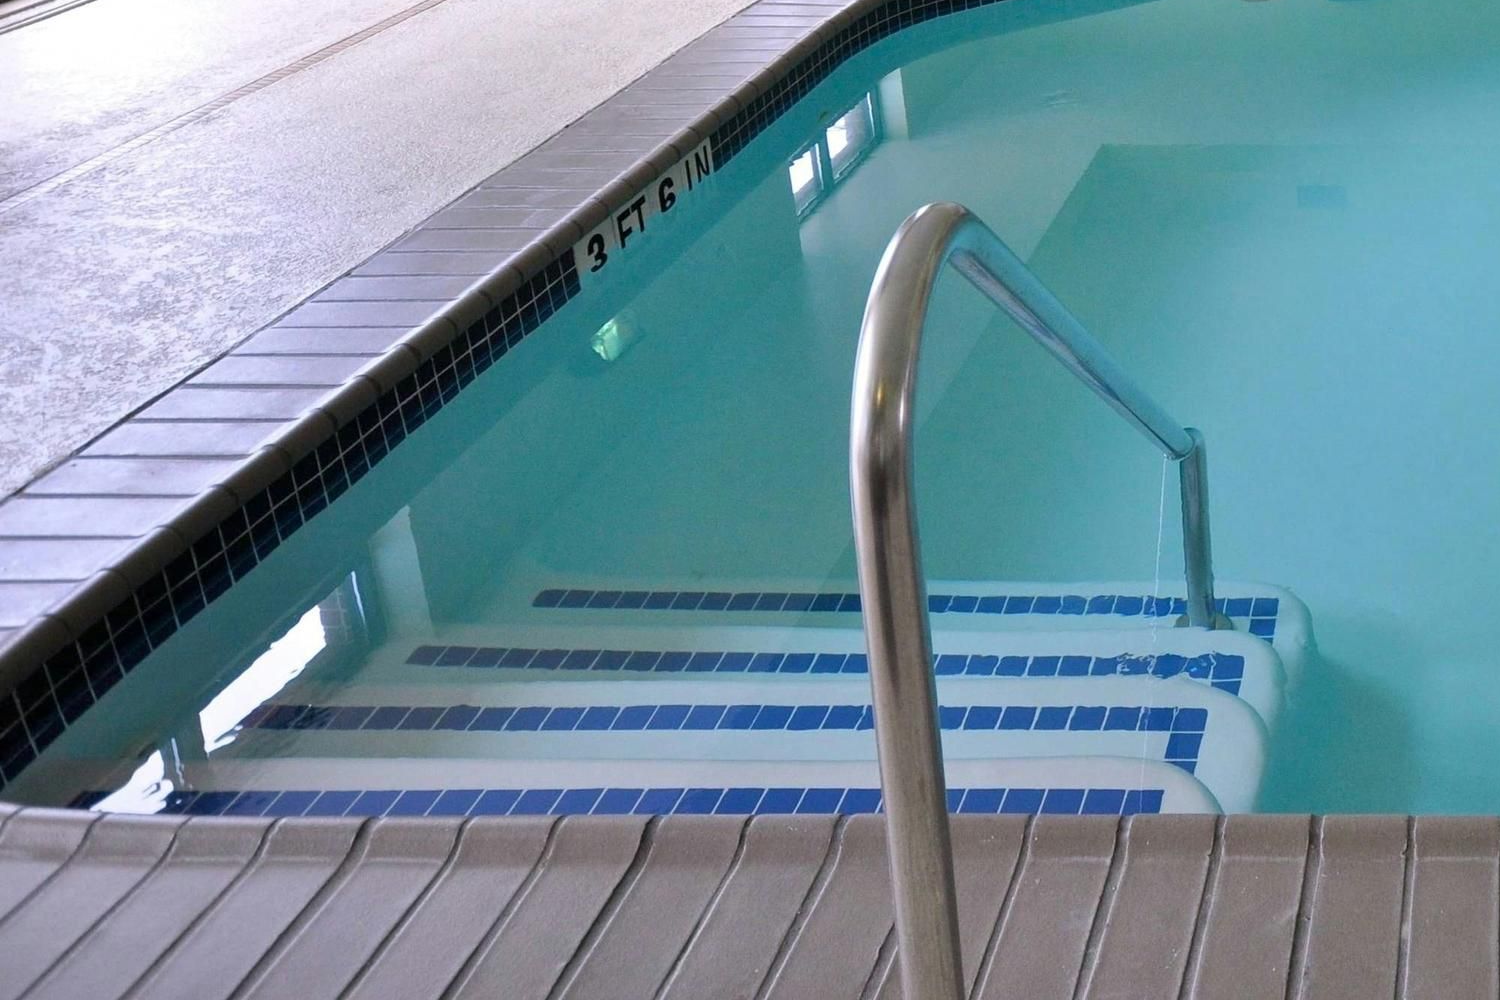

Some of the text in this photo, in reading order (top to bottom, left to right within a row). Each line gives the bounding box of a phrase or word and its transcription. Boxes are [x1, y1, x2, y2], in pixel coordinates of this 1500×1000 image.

[587, 145, 710, 273] 3 FT 6 IN
